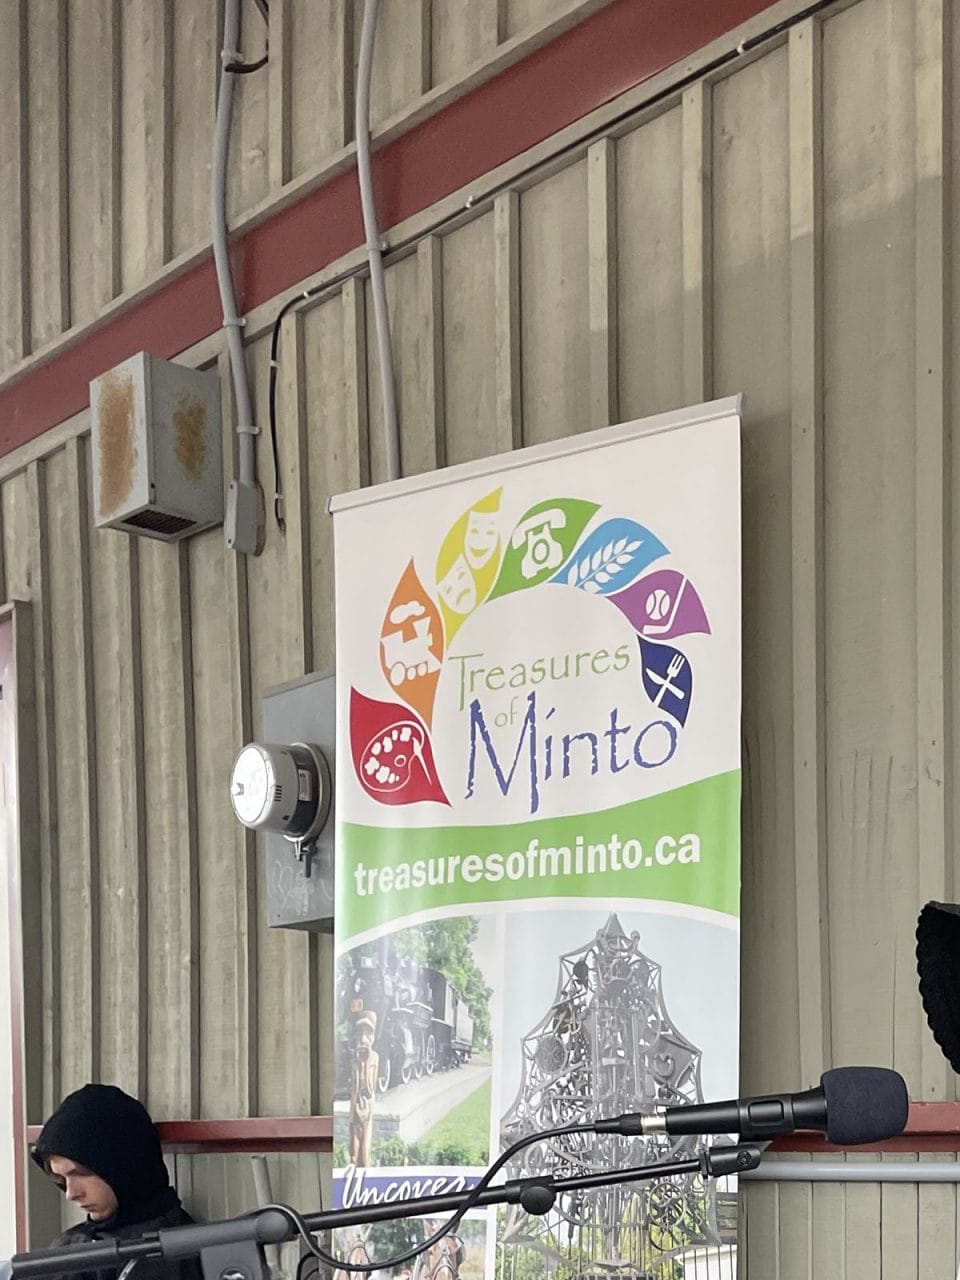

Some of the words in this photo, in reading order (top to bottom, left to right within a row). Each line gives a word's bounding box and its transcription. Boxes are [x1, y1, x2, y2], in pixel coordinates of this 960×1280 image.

[448, 643, 631, 710] Treasures
[494, 695, 520, 728] of
[464, 690, 678, 814] Minto
[354, 832, 701, 896] treasuresofminto.ca
